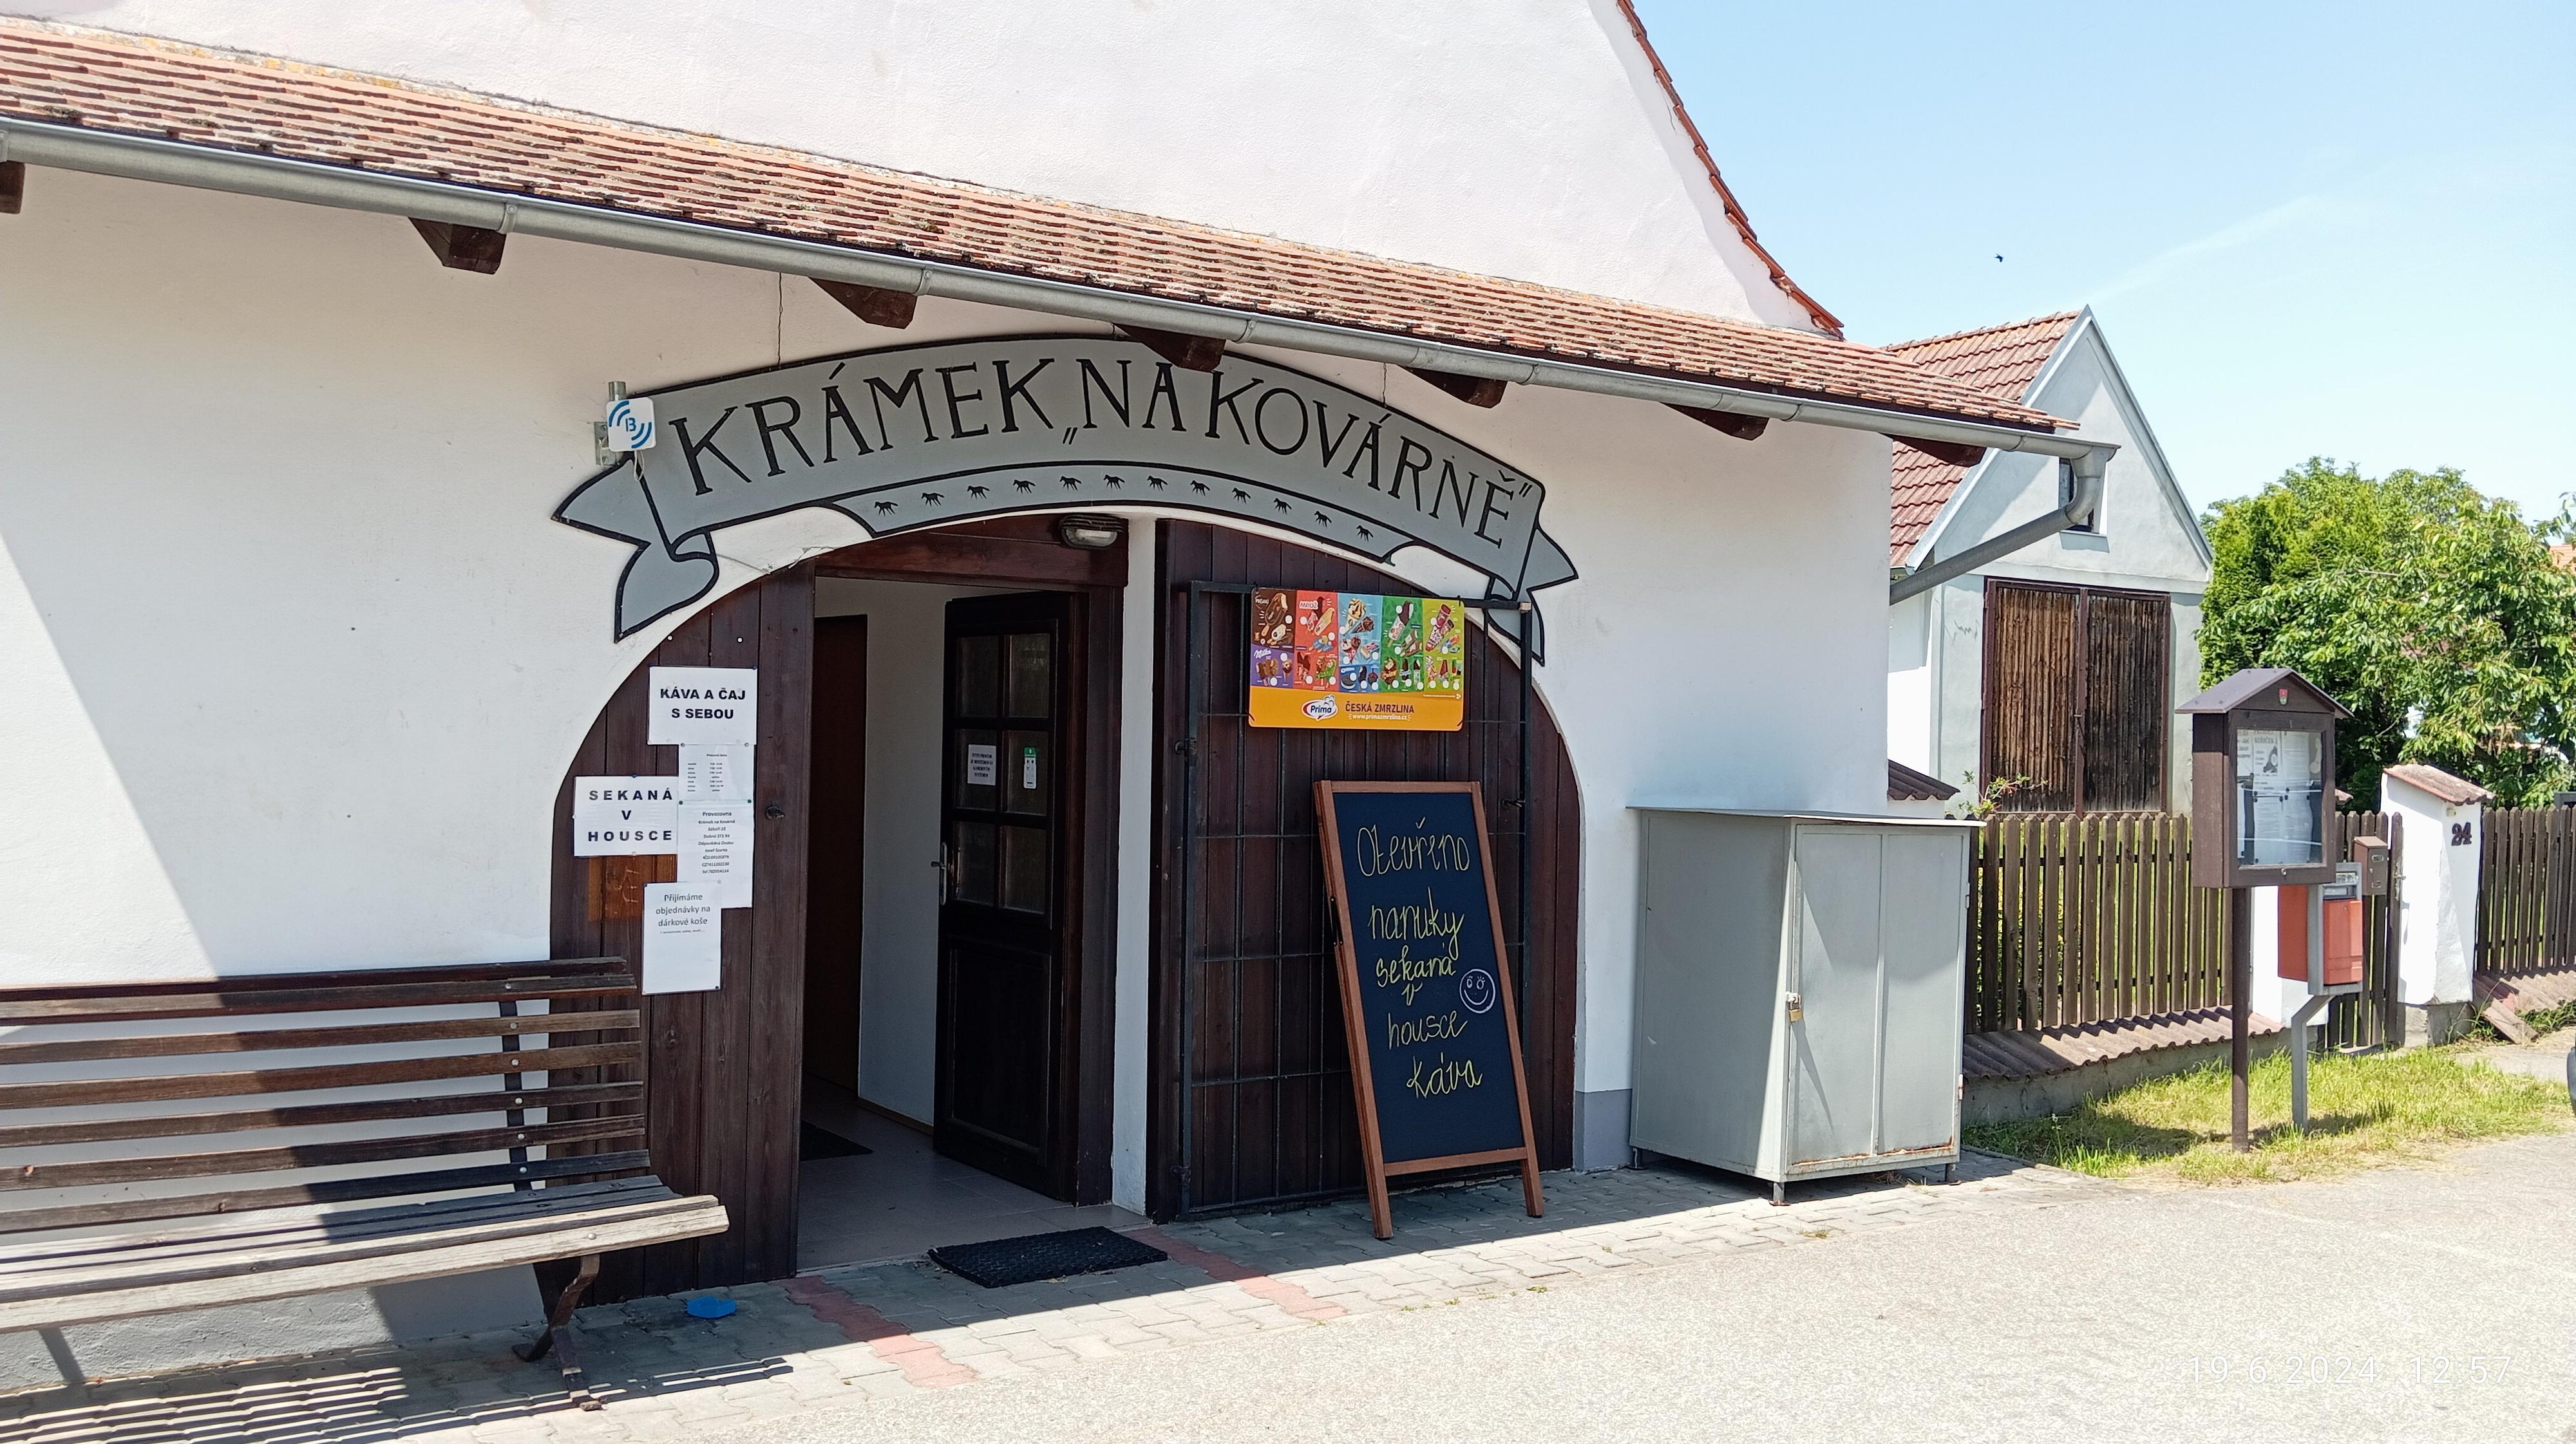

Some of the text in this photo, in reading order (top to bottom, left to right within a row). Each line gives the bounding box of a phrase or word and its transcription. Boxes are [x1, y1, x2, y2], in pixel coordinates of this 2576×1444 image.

[668, 361, 1056, 496] KRÁMEK
[660, 686, 745, 700] KÁVA A ČAJ
[1311, 705, 1332, 714] Prima
[1345, 700, 1415, 713] ČESKÁ ZMRZLINA
[672, 708, 734, 719] S SEBOU
[589, 787, 672, 800] SEKANÁ
[621, 810, 632, 820] V
[588, 830, 672, 841] HOUSCE
[2451, 822, 2472, 846] 24
[1358, 816, 1470, 876] Otevřeno
[664, 894, 703, 903] Přijímáme
[656, 906, 699, 915] objednávky
[658, 917, 708, 926] dárkové koše
[1368, 886, 1464, 961] nanuky
[1388, 1011, 1468, 1050] housce
